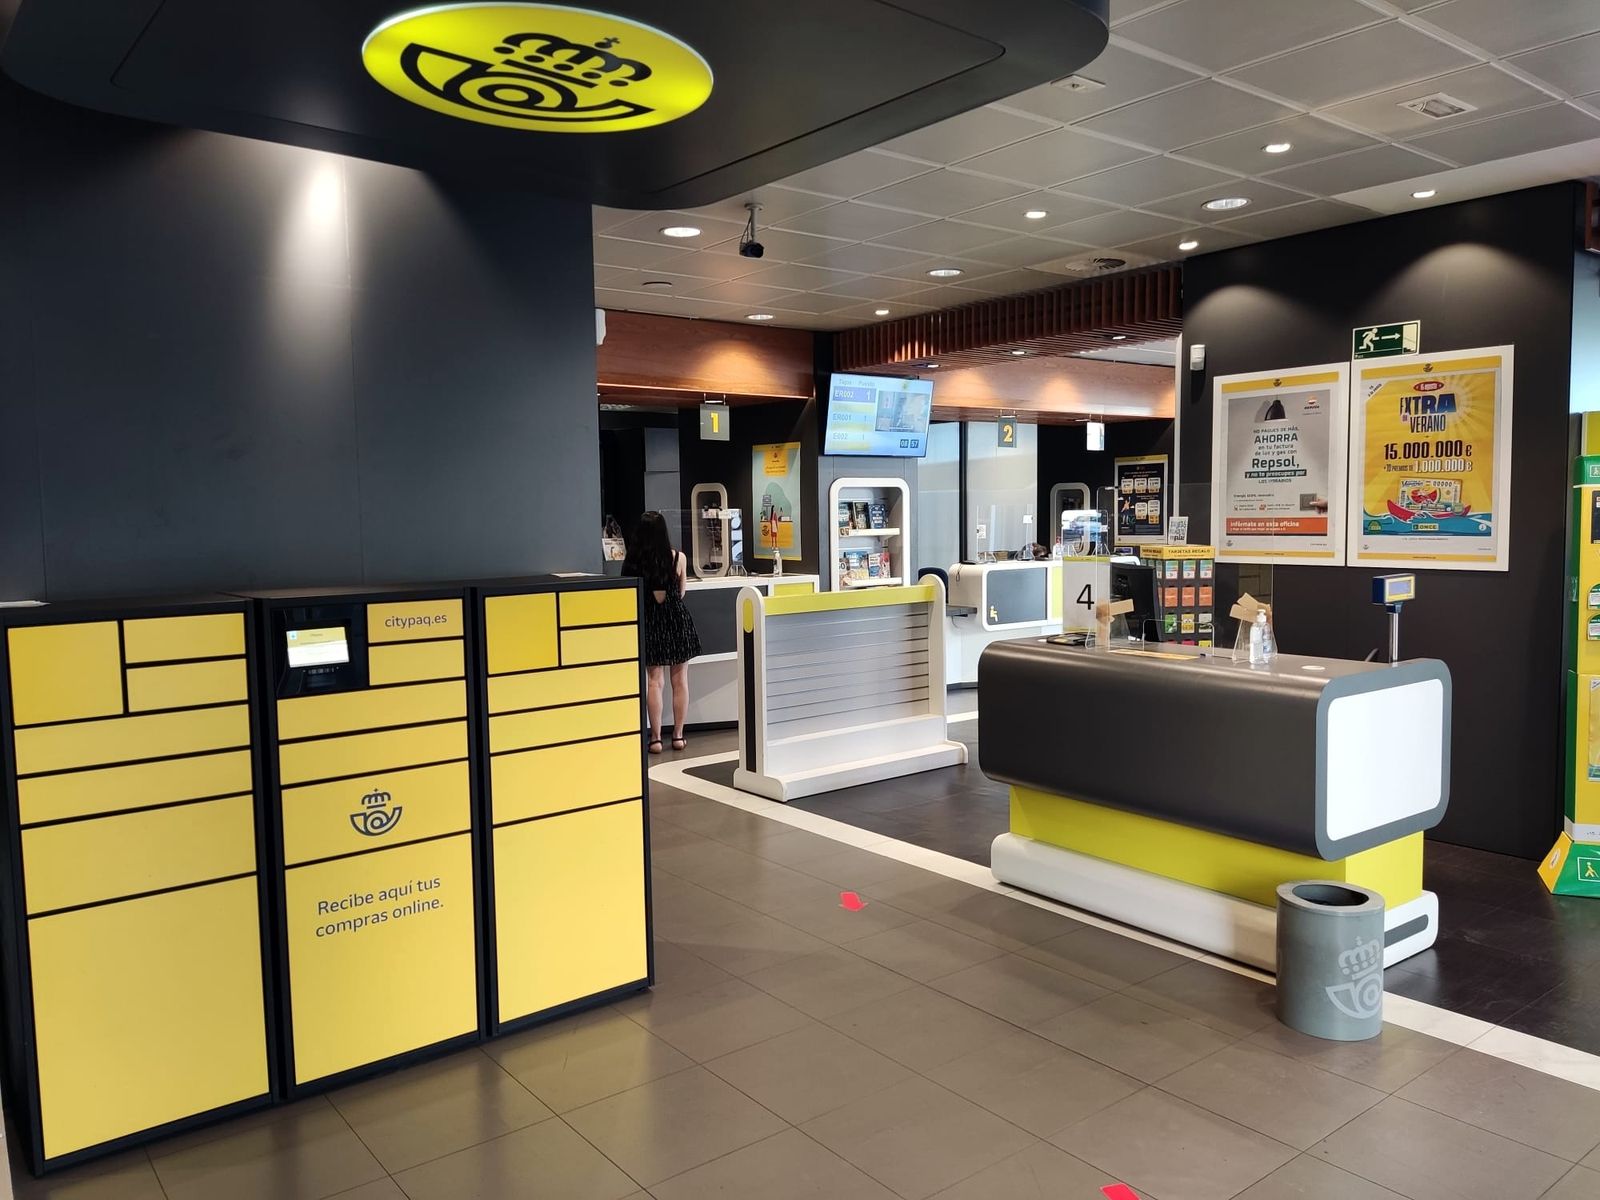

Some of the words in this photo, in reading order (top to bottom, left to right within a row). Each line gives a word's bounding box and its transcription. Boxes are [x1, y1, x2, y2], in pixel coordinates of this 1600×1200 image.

[866, 391, 871, 401] 1
[1400, 393, 1457, 416] EXTRA
[710, 412, 719, 433] 1
[1410, 414, 1446, 434] VERANO
[1003, 424, 1013, 443] 2
[1254, 433, 1298, 444] AHORRA
[1384, 440, 1463, 460] 15.000.000
[1252, 455, 1300, 471] Repsol,
[1077, 584, 1095, 610] 4
[384, 614, 448, 629] citypaq.es
[317, 892, 374, 916] Recibe
[378, 880, 413, 901] aquí
[416, 877, 441, 892] tus
[315, 910, 388, 937] compras
[392, 898, 444, 919] online.
